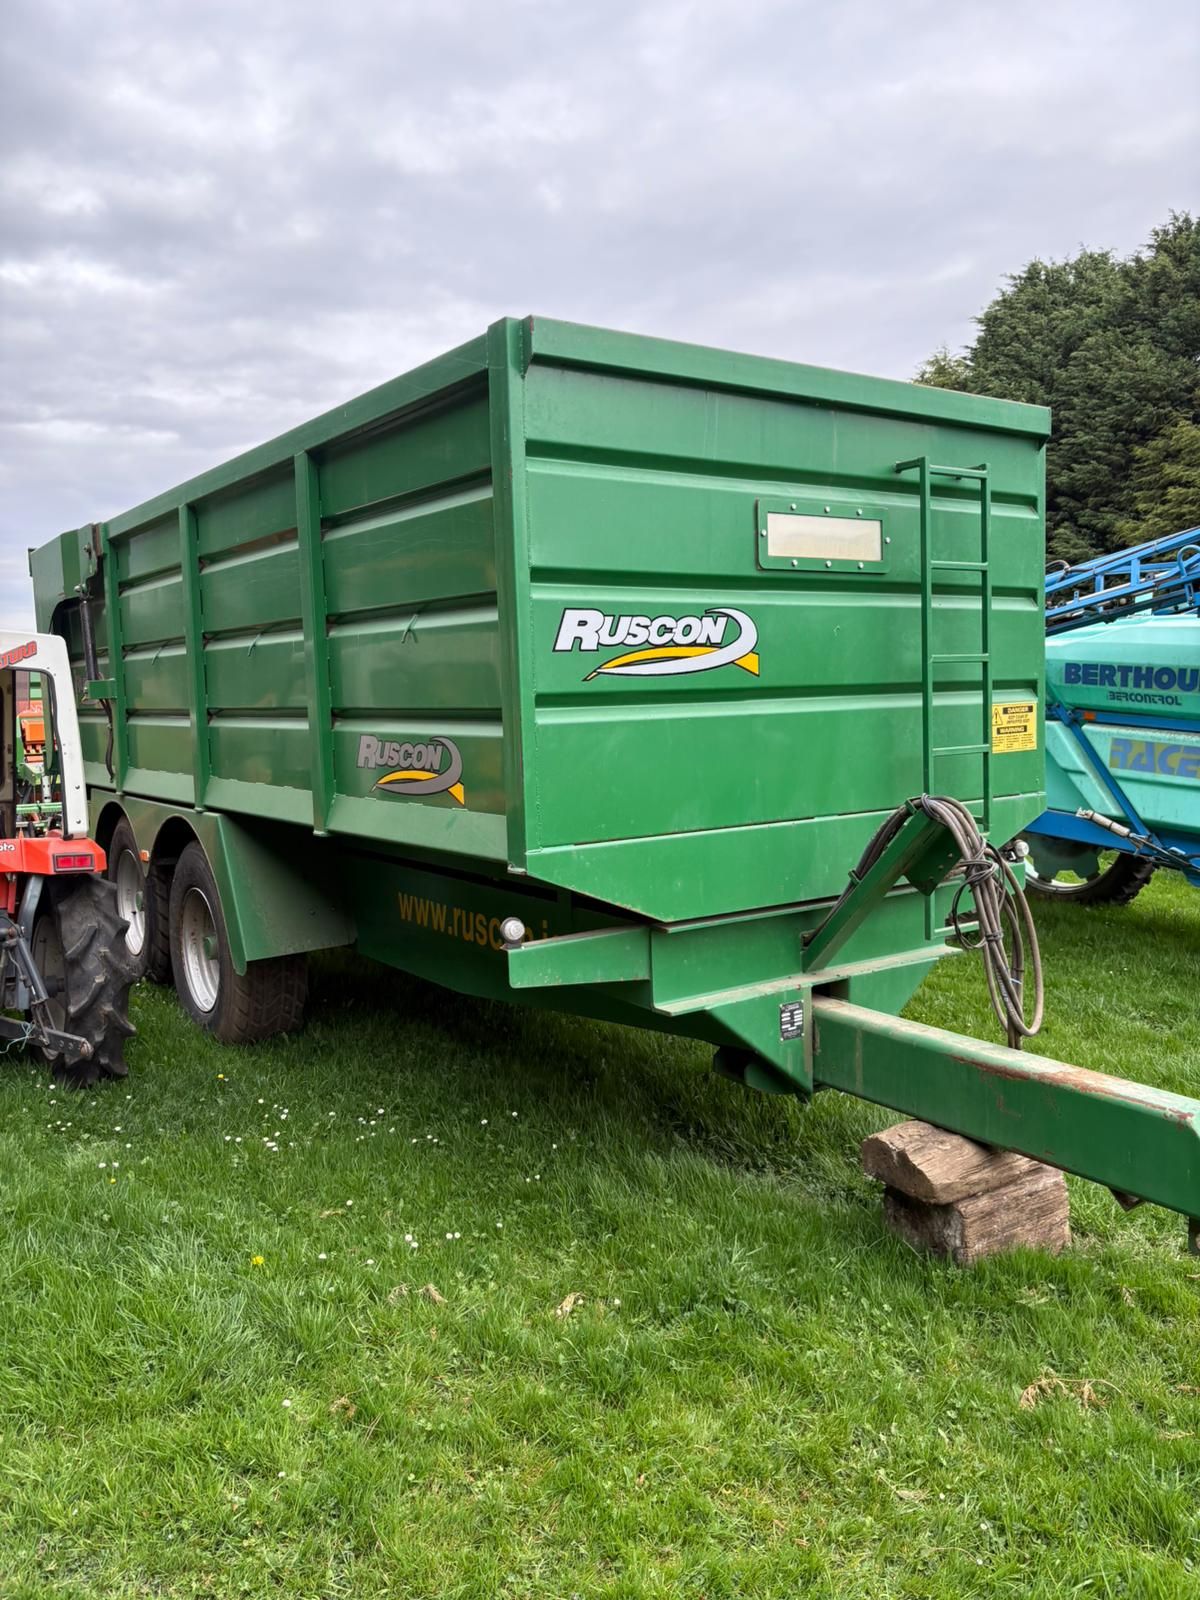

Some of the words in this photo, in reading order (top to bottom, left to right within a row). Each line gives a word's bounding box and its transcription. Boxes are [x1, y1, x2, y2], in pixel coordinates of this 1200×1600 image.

[552, 607, 729, 652] RUSCON
[1064, 662, 1200, 693] BERTHOU
[1107, 690, 1183, 706] BERCONTROL
[356, 734, 444, 772] RUSCON
